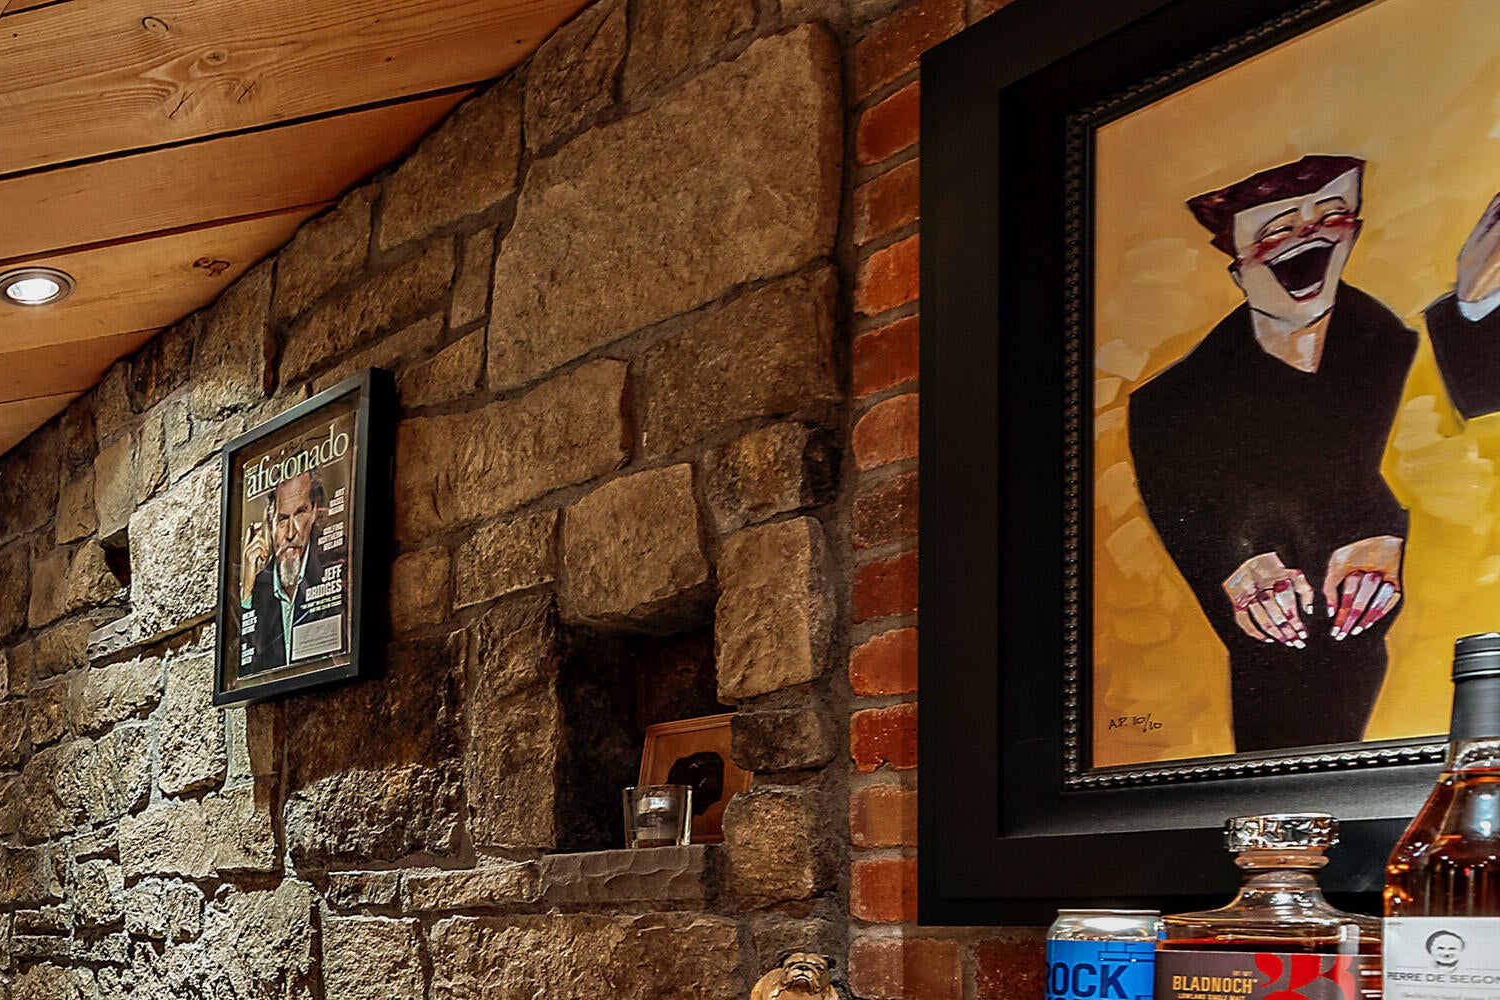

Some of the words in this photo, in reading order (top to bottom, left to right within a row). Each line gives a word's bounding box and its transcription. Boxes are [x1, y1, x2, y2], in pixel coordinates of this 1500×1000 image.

[246, 424, 350, 498] aficionado
[321, 564, 343, 583] JEFF
[305, 579, 342, 602] BRIDGES
[1172, 975, 1253, 994] BLADNOCH
[1426, 973, 1445, 983] DE
